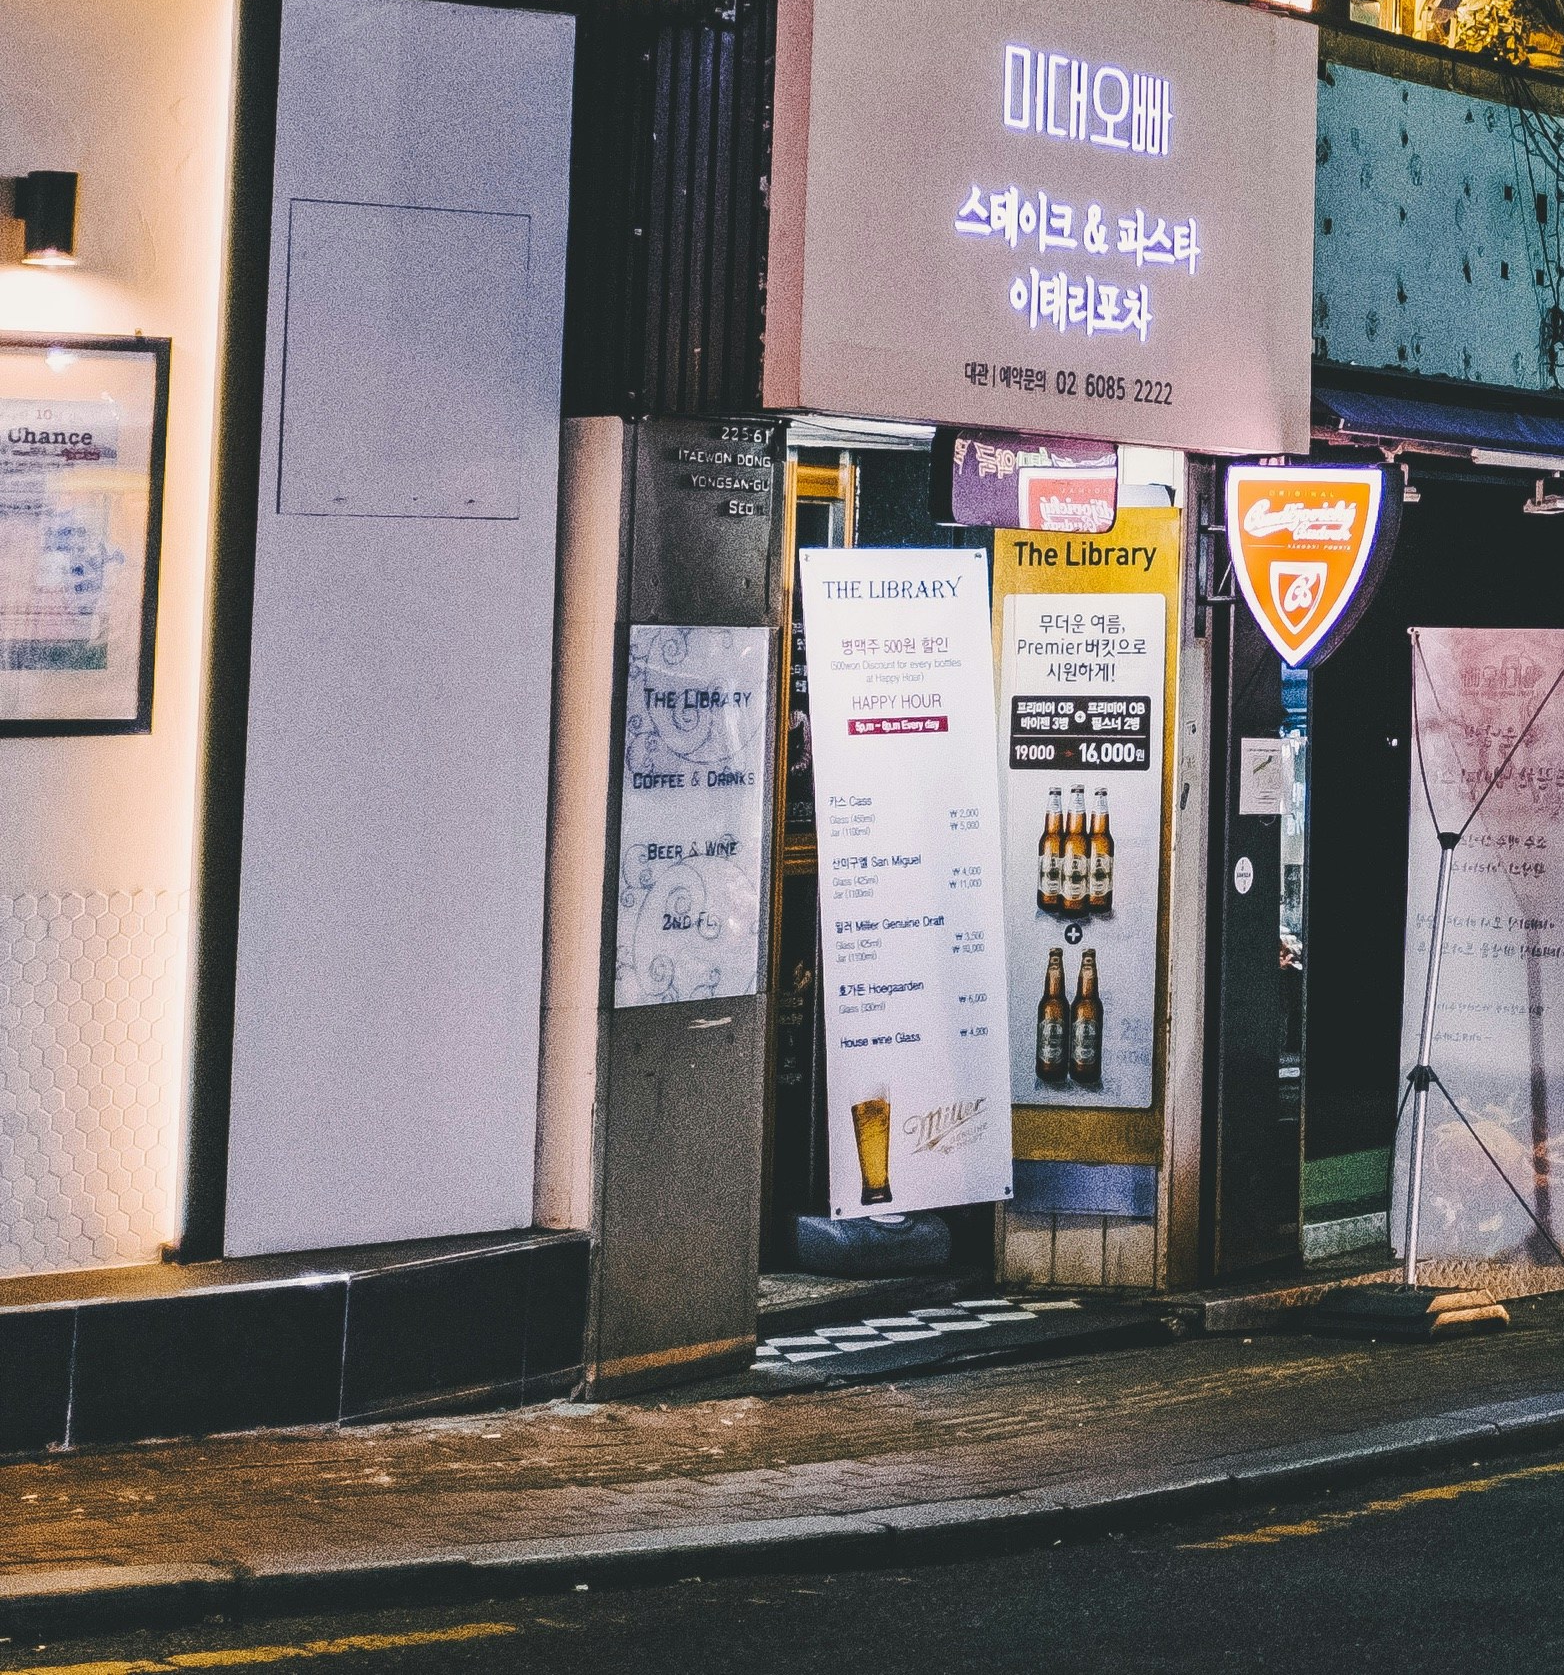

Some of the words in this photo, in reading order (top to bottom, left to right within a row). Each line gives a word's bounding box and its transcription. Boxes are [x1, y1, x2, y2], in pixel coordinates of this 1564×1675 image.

[1002, 42, 1174, 157] 미대오빠
[953, 184, 1078, 254] 스테이크
[1083, 205, 1110, 255] &
[1116, 206, 1202, 276] 파스타
[1008, 266, 1155, 343] 이태리포차
[1055, 370, 1078, 397] 02
[1084, 372, 1127, 402] 6085
[1133, 379, 1175, 407] 2222
[736, 453, 772, 468] DONG
[1013, 540, 1059, 567] The
[1065, 540, 1158, 572] Library
[821, 580, 862, 601] THE
[868, 575, 963, 601] LIBRARY
[1037, 613, 1087, 635] 무더운
[921, 636, 951, 654] 할인
[1046, 662, 1117, 684] 시원하게!
[851, 694, 897, 711] HAPPY
[901, 693, 943, 710] HOUR
